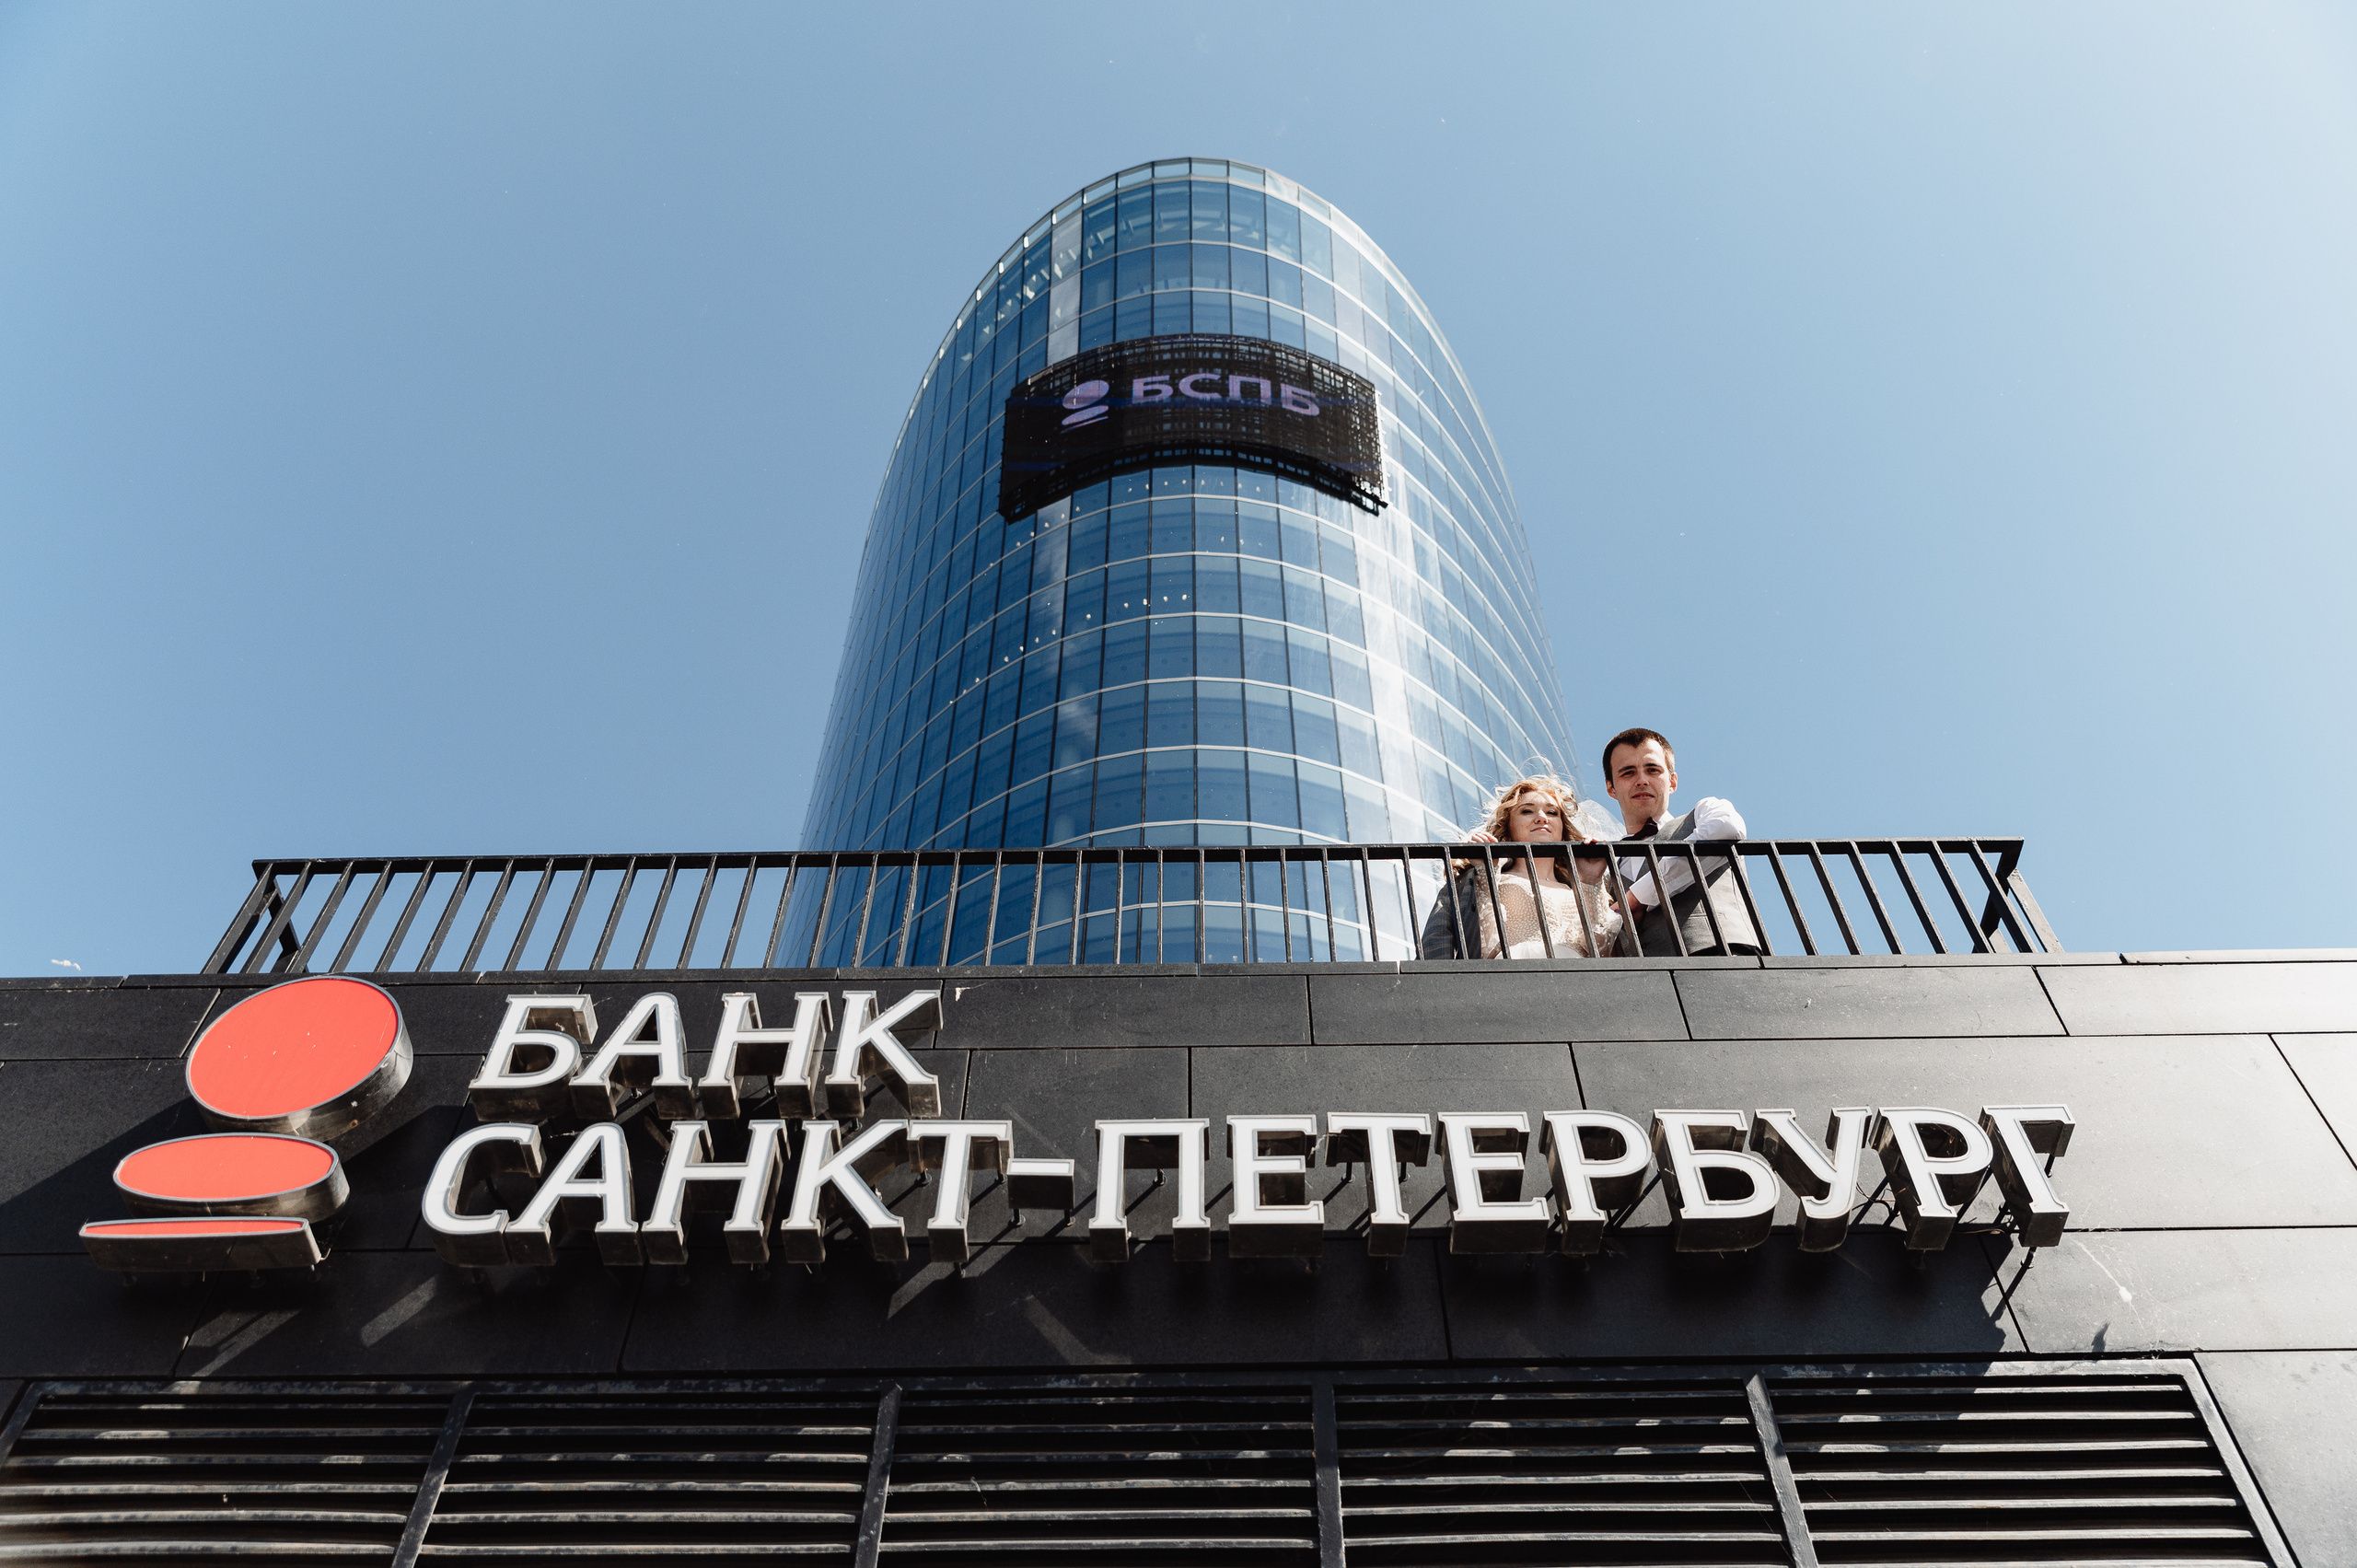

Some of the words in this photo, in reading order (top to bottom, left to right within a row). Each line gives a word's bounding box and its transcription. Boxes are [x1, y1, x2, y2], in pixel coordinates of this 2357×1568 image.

[1132, 373, 1320, 417] БСПБ
[469, 989, 942, 1090] БАНК
[421, 1104, 2074, 1237] САНКТ-ПЕТЕРБУРГ
